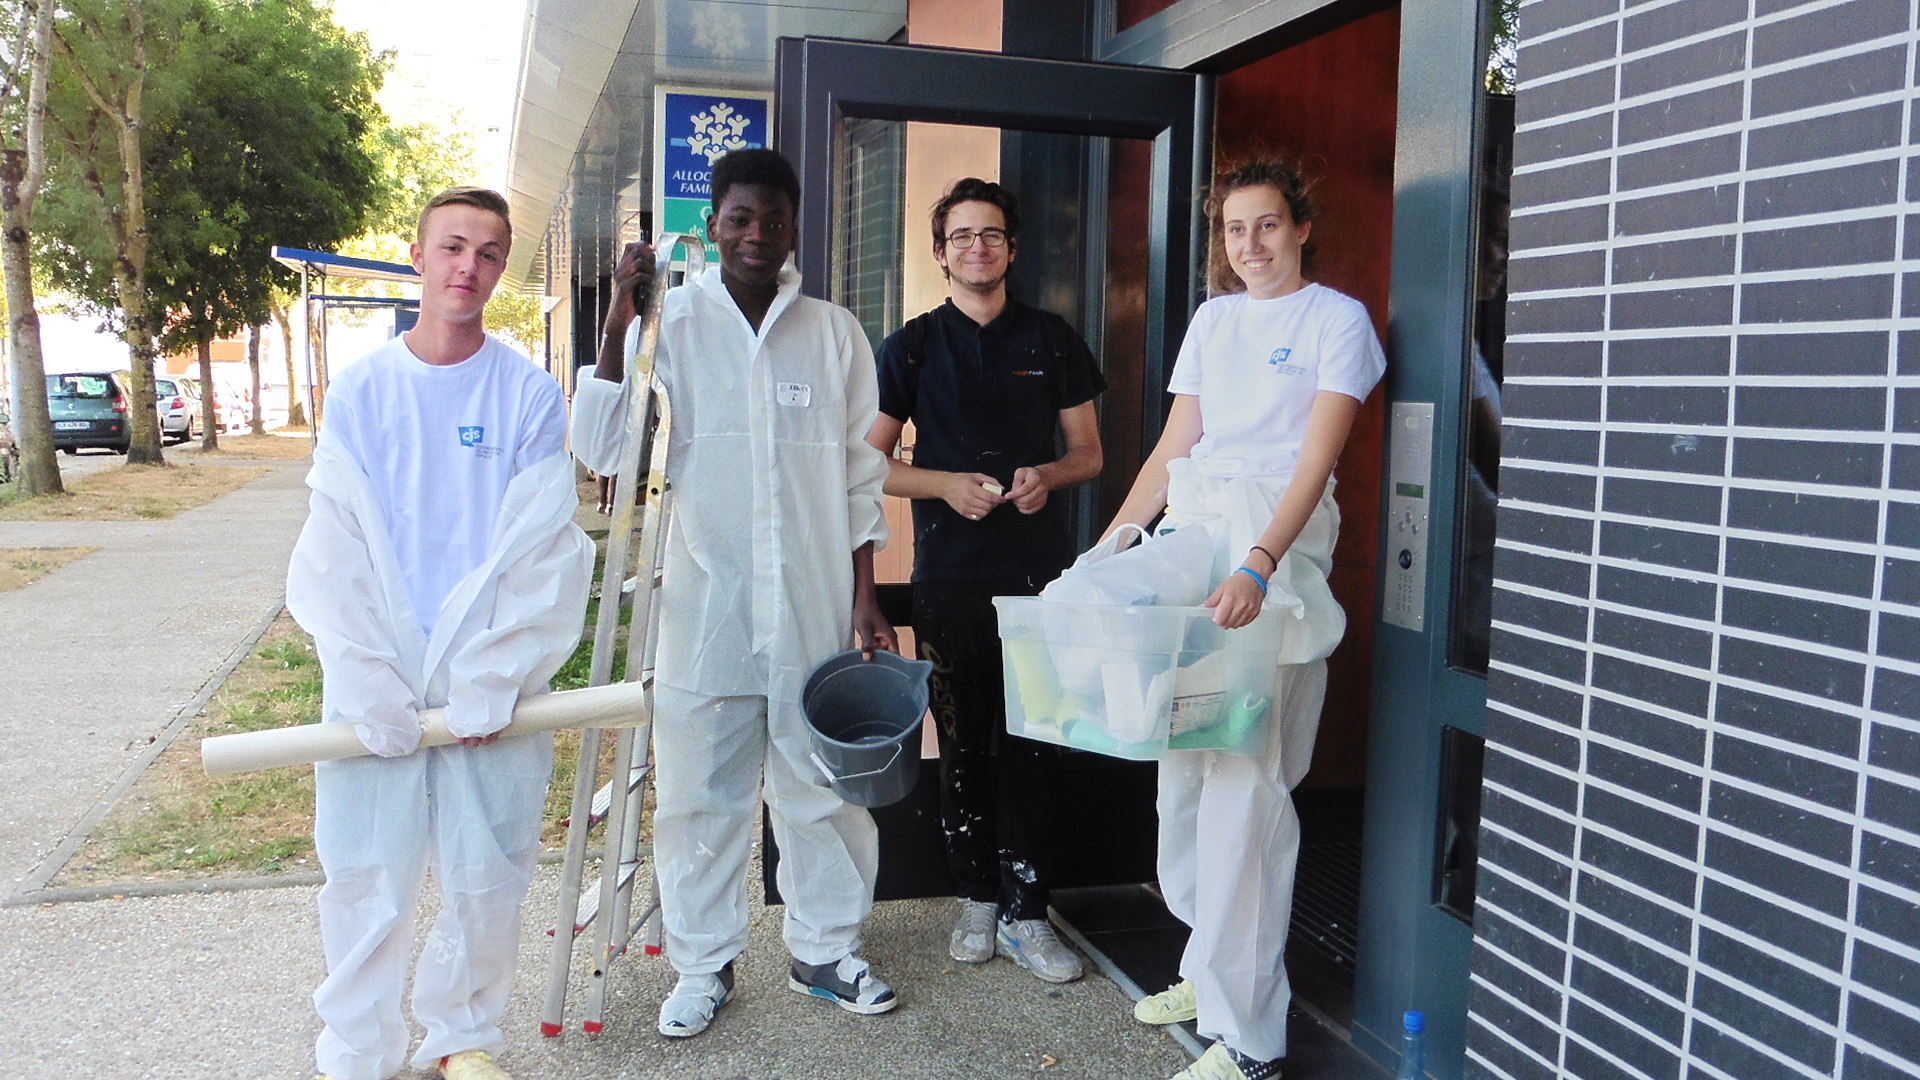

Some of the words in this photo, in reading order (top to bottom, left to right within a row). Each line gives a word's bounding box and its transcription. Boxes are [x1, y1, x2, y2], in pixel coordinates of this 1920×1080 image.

[680, 183, 712, 194] FAMI
[689, 225, 704, 236] de
[462, 428, 481, 442] cjs
